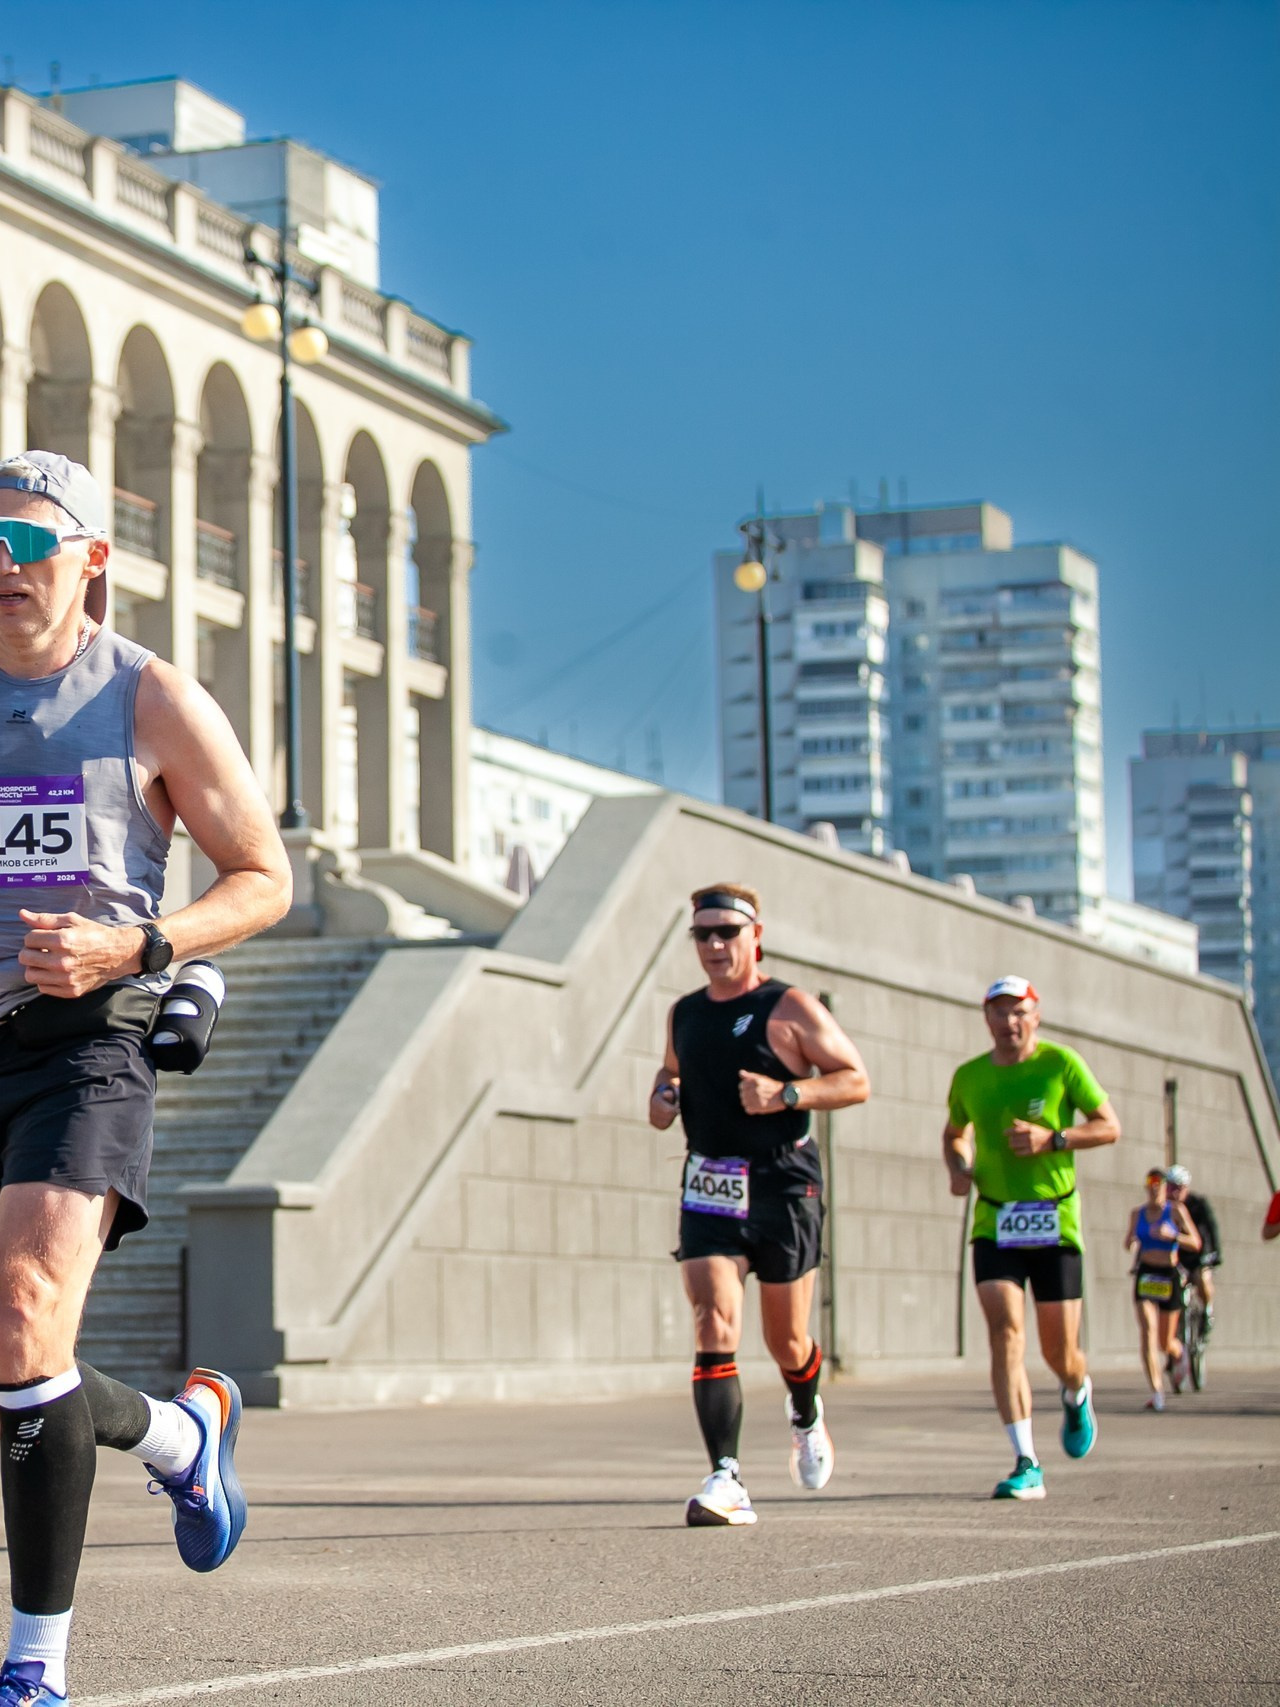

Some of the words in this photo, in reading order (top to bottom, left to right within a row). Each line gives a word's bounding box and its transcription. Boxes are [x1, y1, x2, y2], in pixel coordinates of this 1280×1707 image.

[22, 857, 58, 867] СЕРГЕЙ
[689, 1174, 744, 1200] 4045
[1001, 1214, 1055, 1232] 4055
